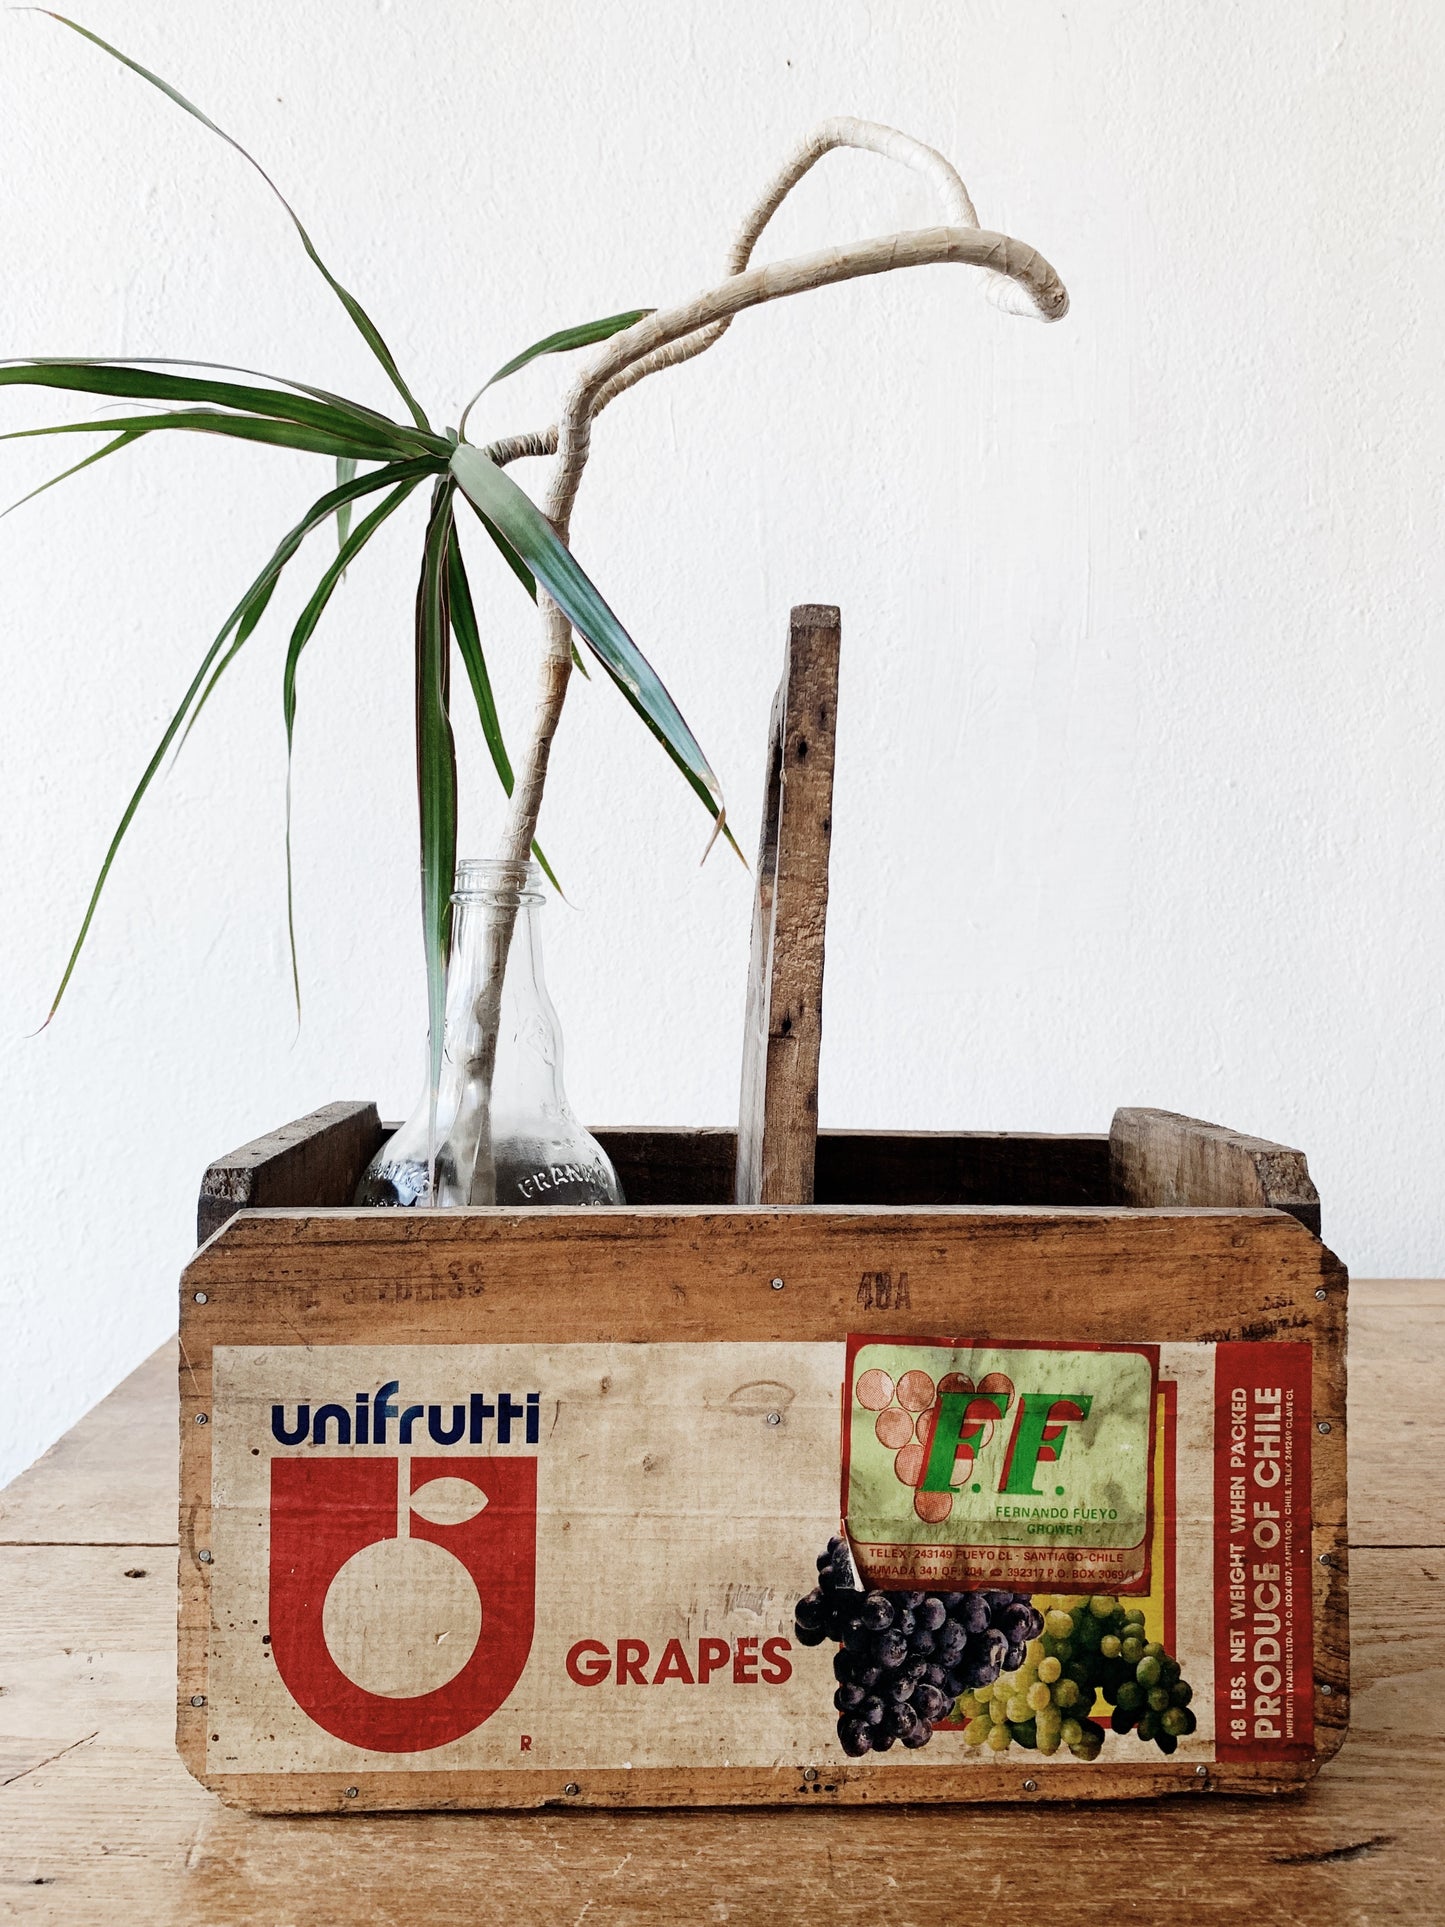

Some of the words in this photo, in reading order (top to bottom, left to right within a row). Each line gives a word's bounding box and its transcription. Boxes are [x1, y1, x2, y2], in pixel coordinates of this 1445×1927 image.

[1286, 1388, 1294, 1400] CL
[271, 1380, 540, 1445] unifrutti
[1230, 1388, 1247, 1468] PACKED
[1285, 1402, 1294, 1429] CLAVE
[1253, 1388, 1281, 1488] CHILE
[1285, 1462, 1293, 1486] TELEX
[996, 1506, 1069, 1518] FERNANDO
[1073, 1507, 1118, 1519] FUEYO
[1230, 1476, 1246, 1533] WHEN
[1027, 1523, 1083, 1535] GROWER
[1252, 1501, 1281, 1549] OF
[914, 1549, 953, 1559] 243149
[956, 1550, 995, 1560] FUEYO
[919, 1566, 938, 1575] 341
[1007, 1567, 1044, 1577] 392317
[1047, 1568, 1069, 1578] P.O.
[1072, 1569, 1095, 1578] BOX
[1229, 1543, 1246, 1620] WEIGHT
[1285, 1588, 1293, 1607] BOX
[565, 1637, 793, 1685] GRAPES
[1229, 1628, 1246, 1662] NET
[1252, 1563, 1281, 1739] PRODUCE
[1230, 1671, 1246, 1709] LBS.
[1286, 1654, 1294, 1693] TRADERS
[1230, 1719, 1246, 1740] 18
[1285, 1695, 1294, 1738] UNIFRUTTI
[520, 1735, 532, 1751] R
